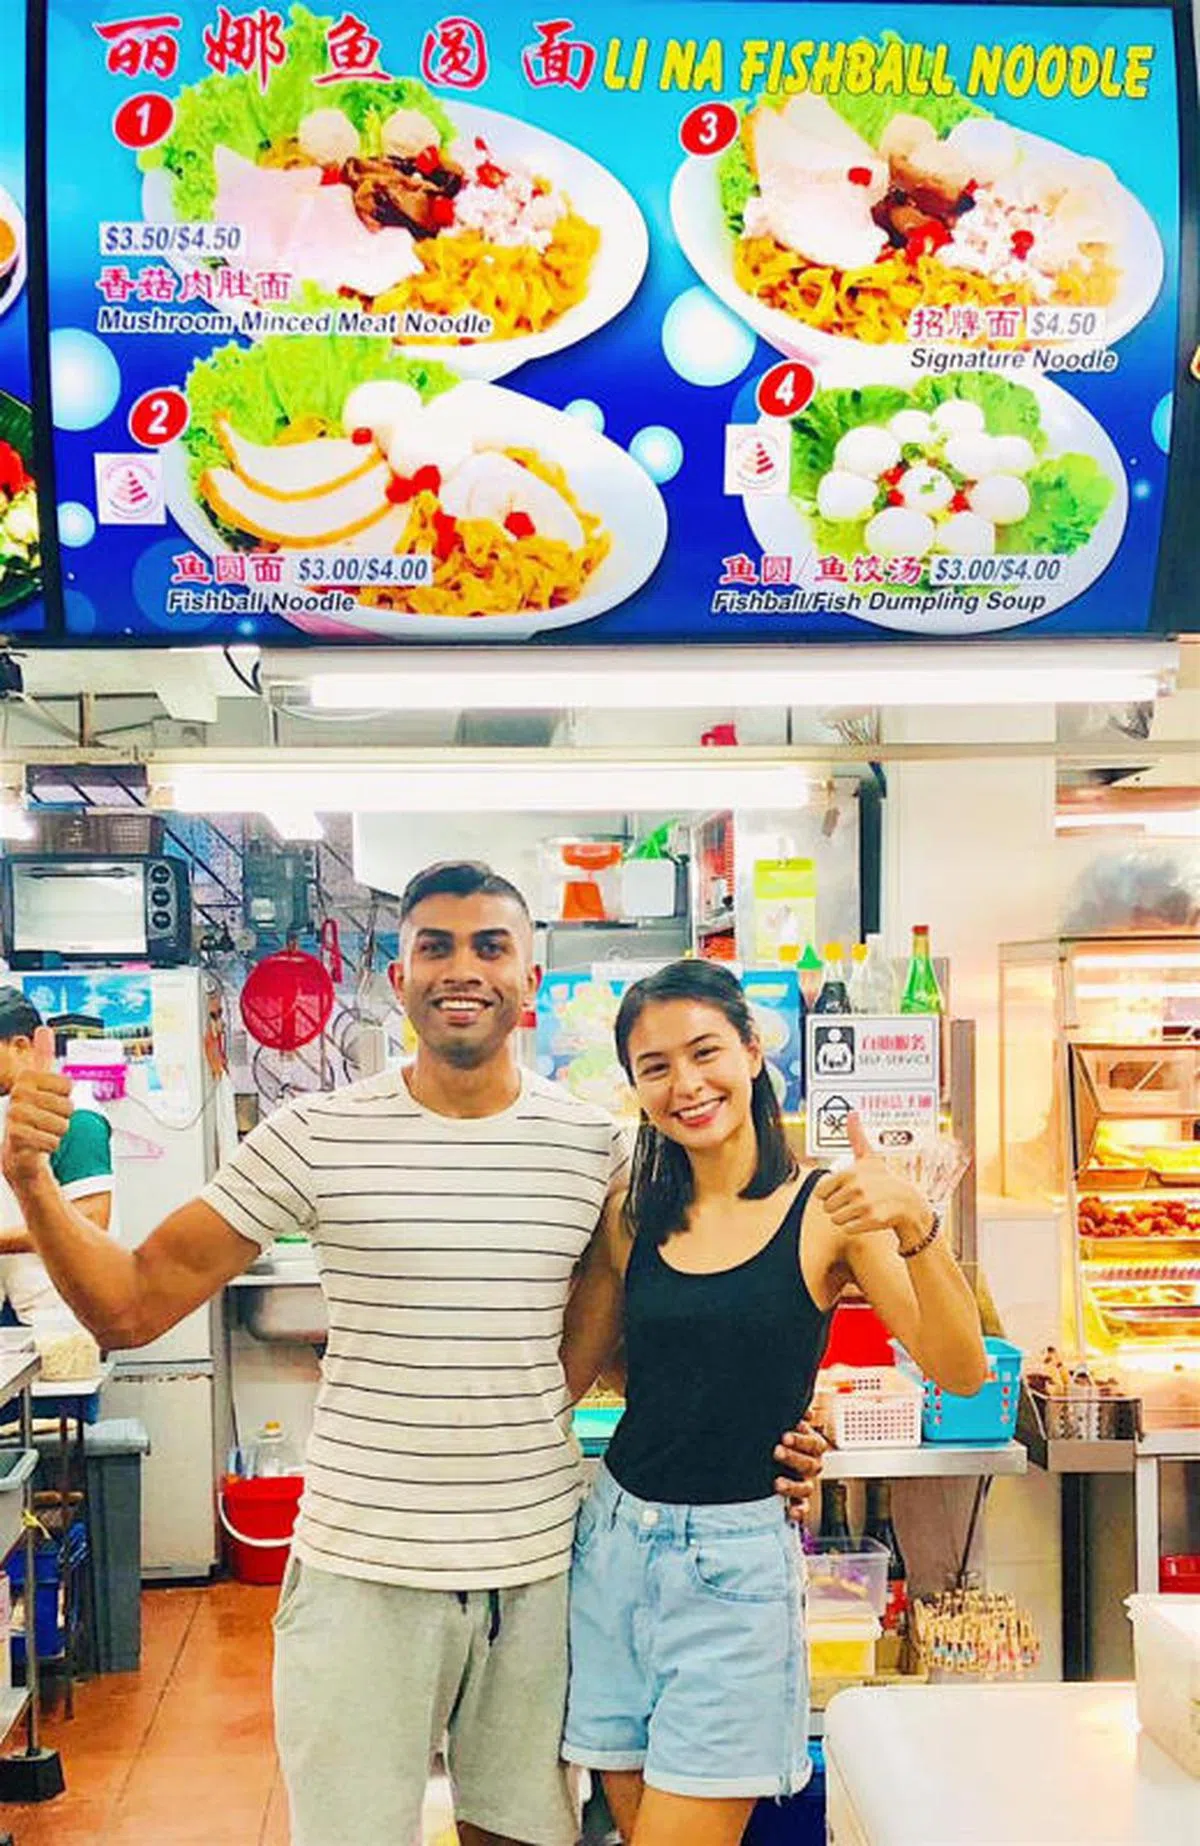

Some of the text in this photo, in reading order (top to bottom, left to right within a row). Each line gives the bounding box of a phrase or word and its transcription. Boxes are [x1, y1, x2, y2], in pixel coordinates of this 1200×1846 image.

[95, 8, 596, 93] 丽娜鱼圆面
[604, 38, 1154, 98] LI NA FISHBALL NOODLE
[136, 101, 151, 138] 1
[699, 111, 718, 145] 3
[105, 226, 241, 251] $3.50/$4.50
[100, 309, 492, 333] Mushroom Minced Meat Noodle
[911, 308, 1020, 338] 招牌面
[1031, 312, 1096, 336] $4.50
[910, 347, 1117, 373] Signature Noodle
[775, 370, 795, 407] 4
[148, 399, 169, 434] 2
[173, 554, 285, 583] 鱼圆面
[299, 557, 428, 582] $3.00/$4.00
[935, 558, 1061, 581] $3.00/$4.00
[168, 591, 355, 613] Fishball Noodle
[713, 591, 1046, 614] Fishball/Fish Dumpling Soup
